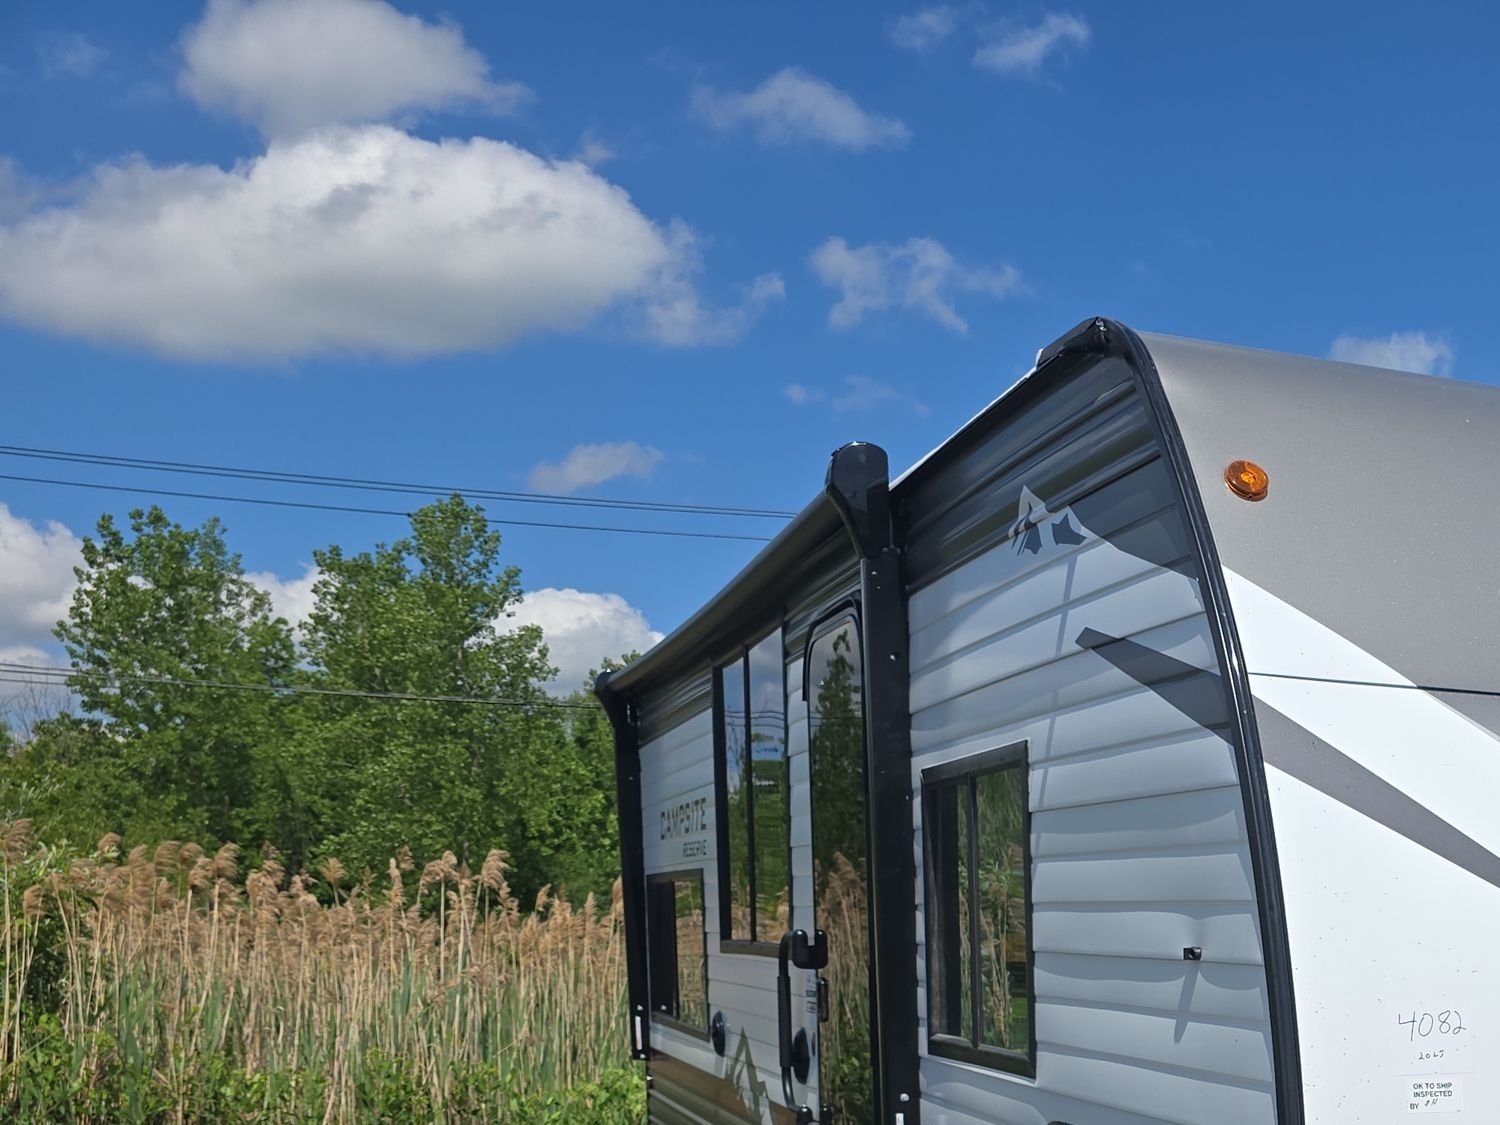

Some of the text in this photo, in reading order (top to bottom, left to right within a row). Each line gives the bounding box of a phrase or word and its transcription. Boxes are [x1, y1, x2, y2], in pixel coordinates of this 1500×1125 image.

[660, 797, 706, 841] CAMPSITE
[1398, 1010, 1467, 1042] 4082
[1412, 1082, 1453, 1090] OK TO SHIP
[1413, 1090, 1453, 1098] INSPECTED
[1409, 1102, 1420, 1110] BY
